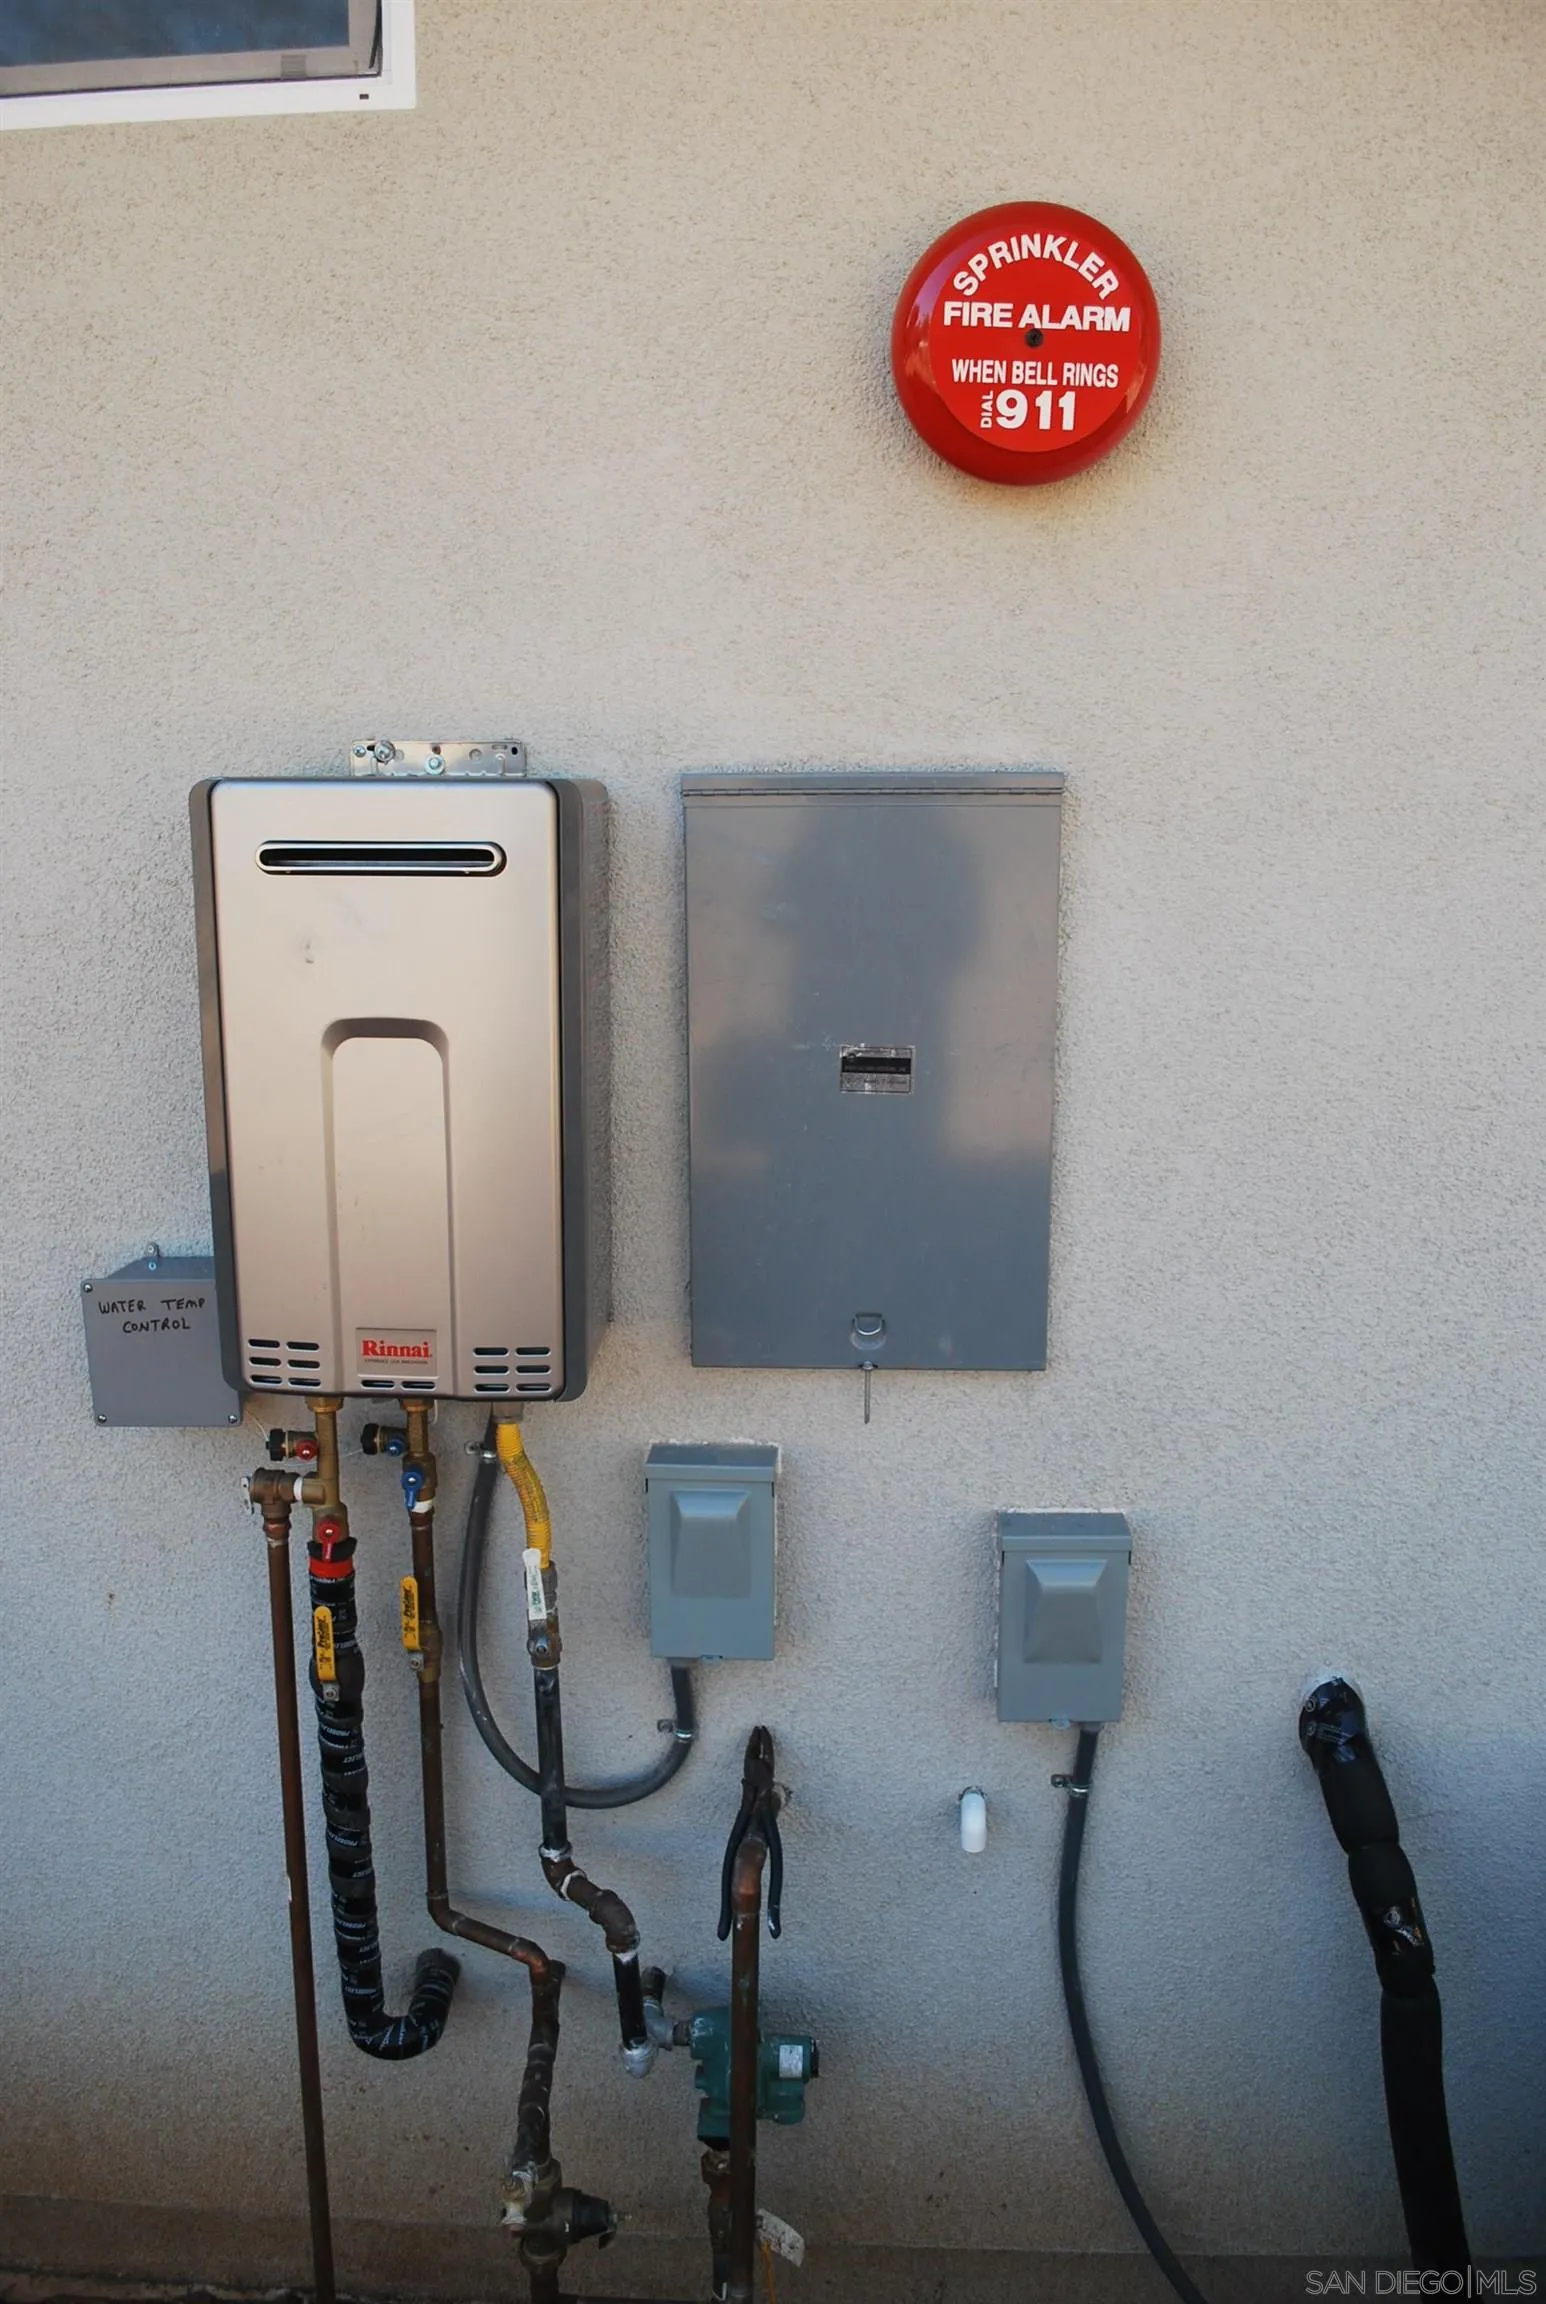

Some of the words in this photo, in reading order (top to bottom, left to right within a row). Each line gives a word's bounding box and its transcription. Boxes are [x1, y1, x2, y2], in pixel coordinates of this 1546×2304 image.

[953, 233, 1120, 300] SPRINKLER
[943, 301, 1014, 328] FIRE
[1018, 304, 1131, 332] ALARM
[952, 359, 1007, 384] WHEN
[1011, 361, 1057, 386] BELL
[1062, 362, 1119, 388] RINGS
[980, 390, 994, 428] DIAL
[996, 389, 1076, 431] 911
[98, 1299, 147, 1315] WATER
[160, 1298, 206, 1311] TEMP
[122, 1317, 191, 1334] CONTROL
[362, 1339, 430, 1358] Rinnai
